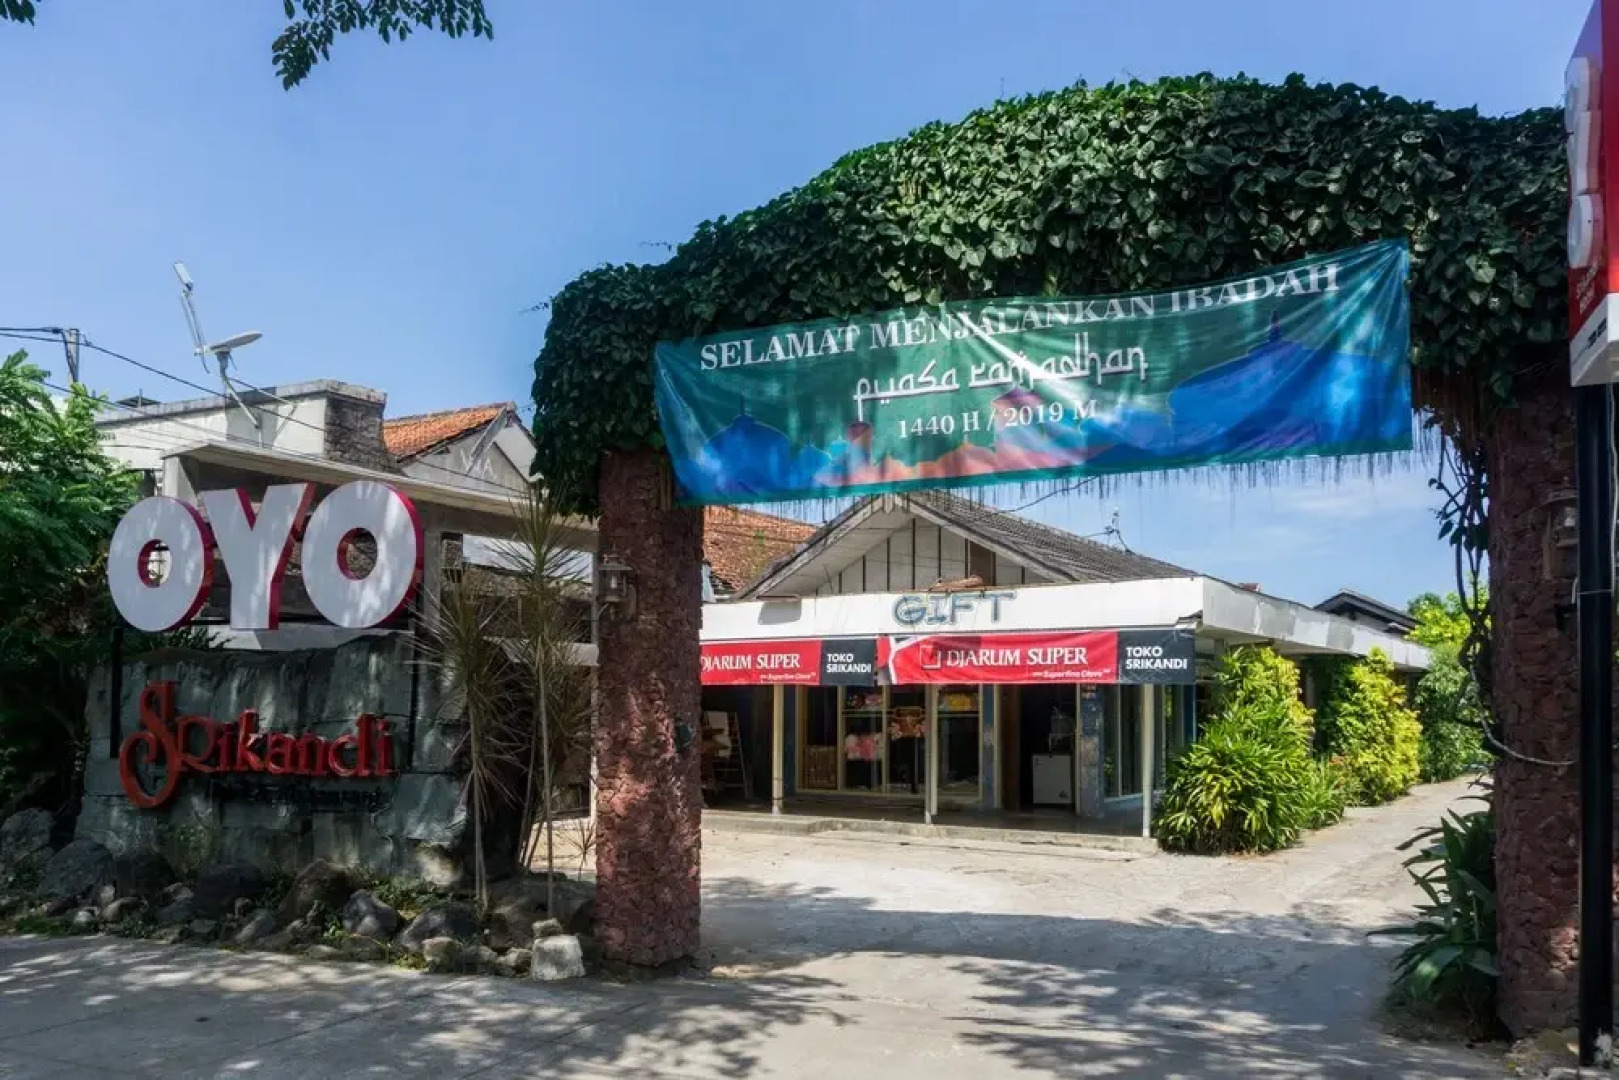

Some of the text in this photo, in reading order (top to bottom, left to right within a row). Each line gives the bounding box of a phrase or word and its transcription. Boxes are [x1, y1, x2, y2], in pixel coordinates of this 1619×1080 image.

[700, 324, 861, 371] SELAMAT
[869, 294, 1155, 350] MENJALANKAN
[853, 359, 960, 422] puasa
[899, 416, 955, 438] 1440
[962, 412, 980, 432] H
[1003, 401, 1063, 428] 2019
[1073, 400, 1098, 420] M
[108, 480, 424, 632] OYO
[894, 592, 1016, 627] GIFT
[756, 653, 801, 670] SUPER
[826, 653, 855, 663] TOKO
[946, 647, 1088, 669] DJARUM SUPER
[1126, 645, 1163, 657] TOKO
[826, 663, 872, 674] SRIKANDI
[1125, 657, 1188, 671] SRIKANDI
